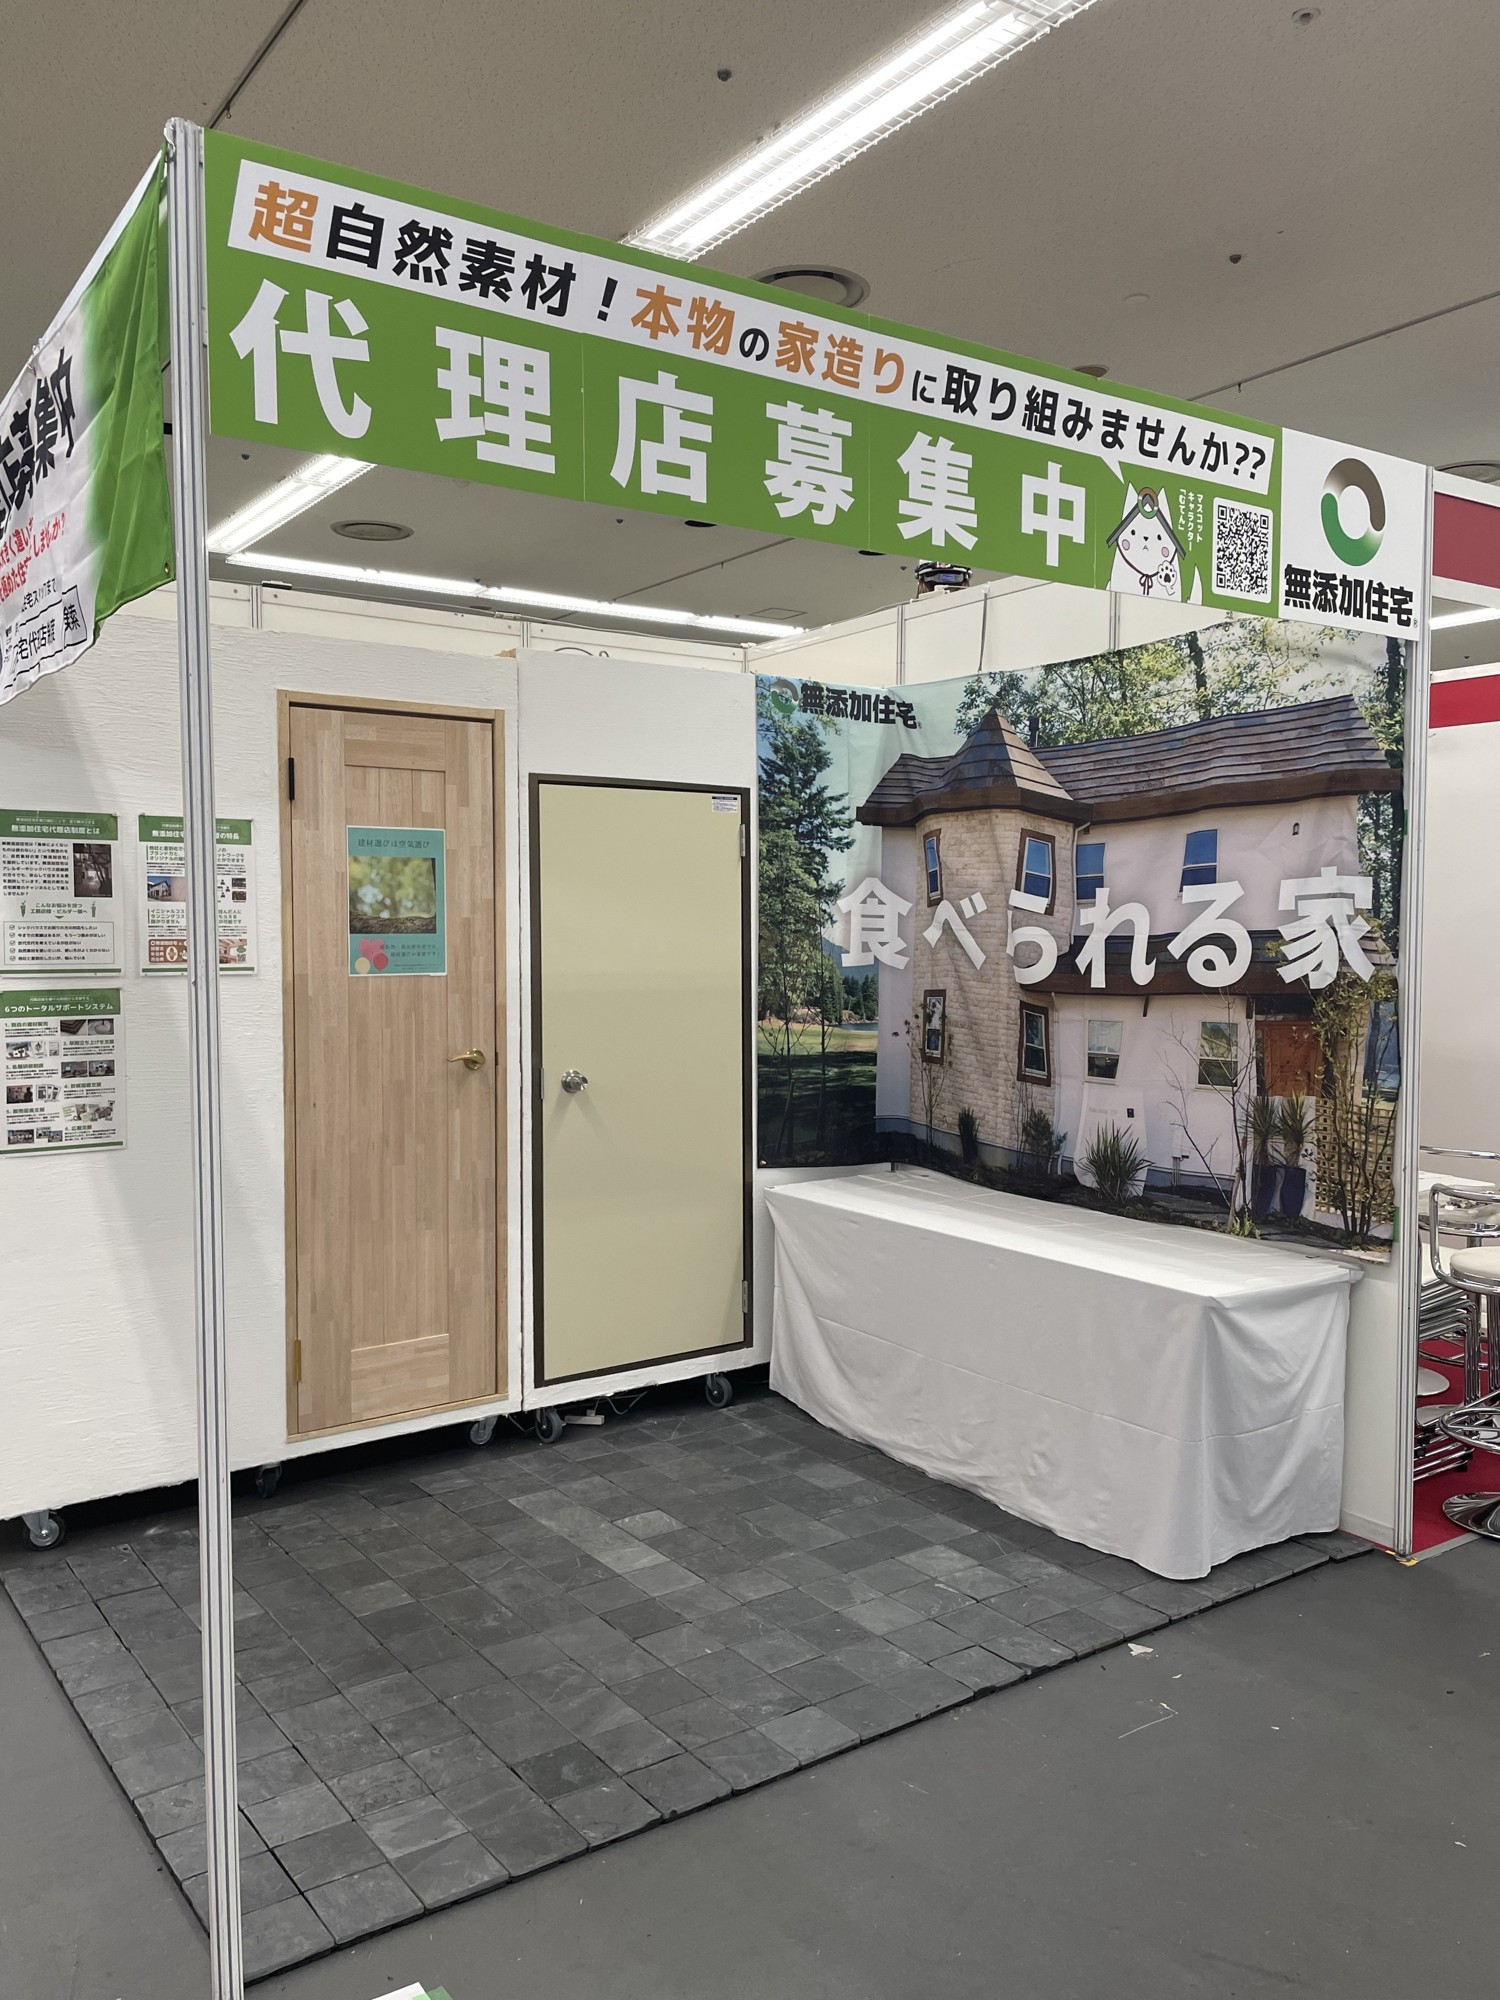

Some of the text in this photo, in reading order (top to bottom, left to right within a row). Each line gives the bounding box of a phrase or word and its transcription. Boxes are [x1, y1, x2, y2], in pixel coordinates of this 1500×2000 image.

[229, 279, 1086, 566] 代理店募集中
[1178, 489, 1186, 530] 「むてん」
[1284, 564, 1414, 627] 無添加住宅
[800, 683, 918, 729] 無添加住宅
[837, 866, 1374, 989] 食べられる家
[5, 1003, 113, 1013] 6つのトータルサポートシステム
